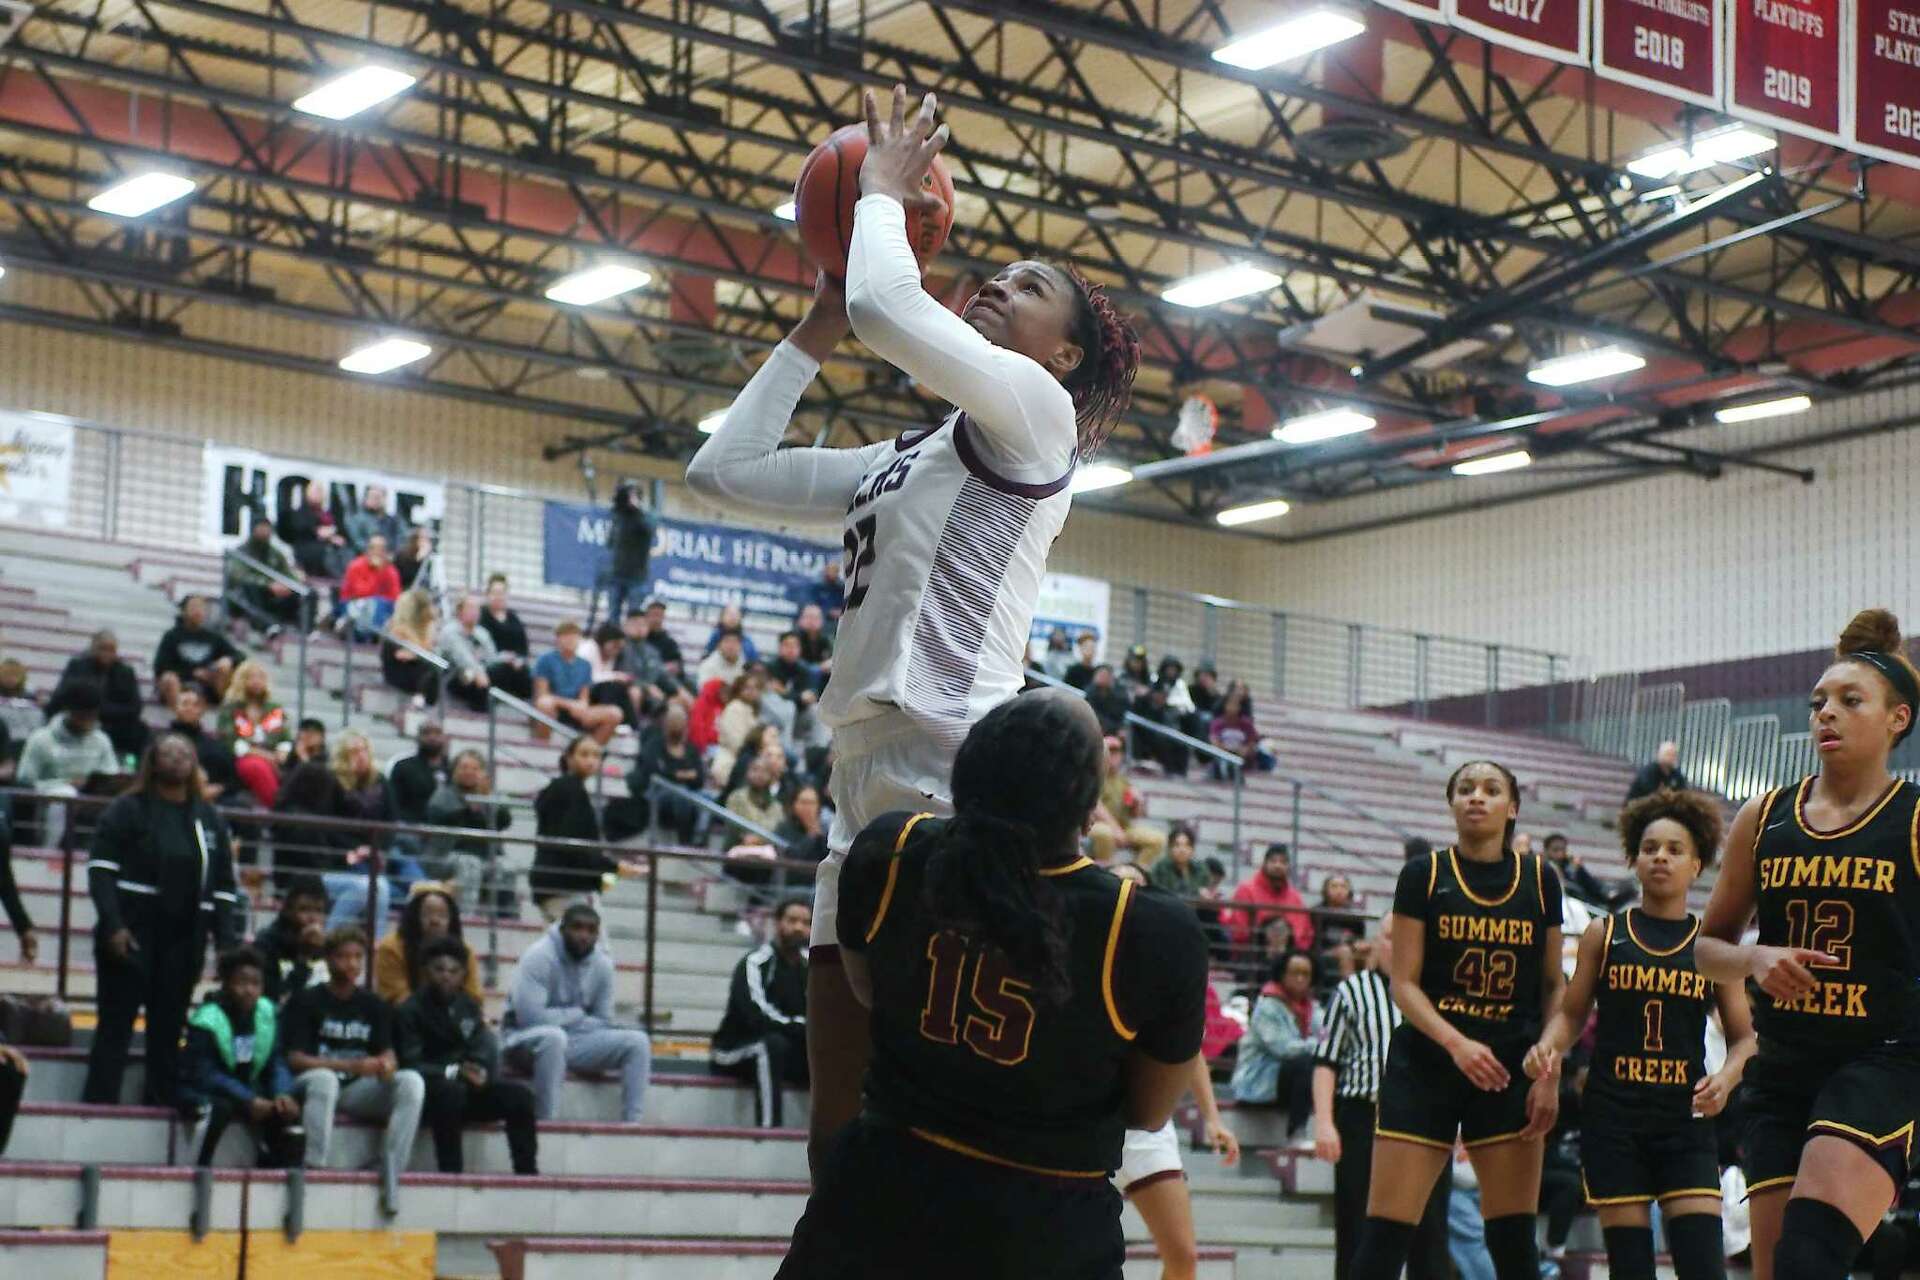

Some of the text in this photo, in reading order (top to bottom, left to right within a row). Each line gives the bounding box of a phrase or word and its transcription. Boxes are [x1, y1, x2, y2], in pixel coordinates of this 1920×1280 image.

[1754, 0, 1824, 38] PLAYOFFS
[1634, 25, 1684, 70] 2018
[1764, 65, 1812, 109] 2019
[1759, 855, 1897, 893] SUMMER
[1439, 914, 1534, 945] SUMMER
[1786, 899, 1855, 970] 12
[1453, 947, 1517, 998] 42
[1609, 964, 1706, 1000] SUMMER
[920, 931, 1036, 1066] 15
[1772, 980, 1869, 1018] EEK
[1644, 999, 1664, 1051] 1
[1615, 1055, 1688, 1084] CREEK
